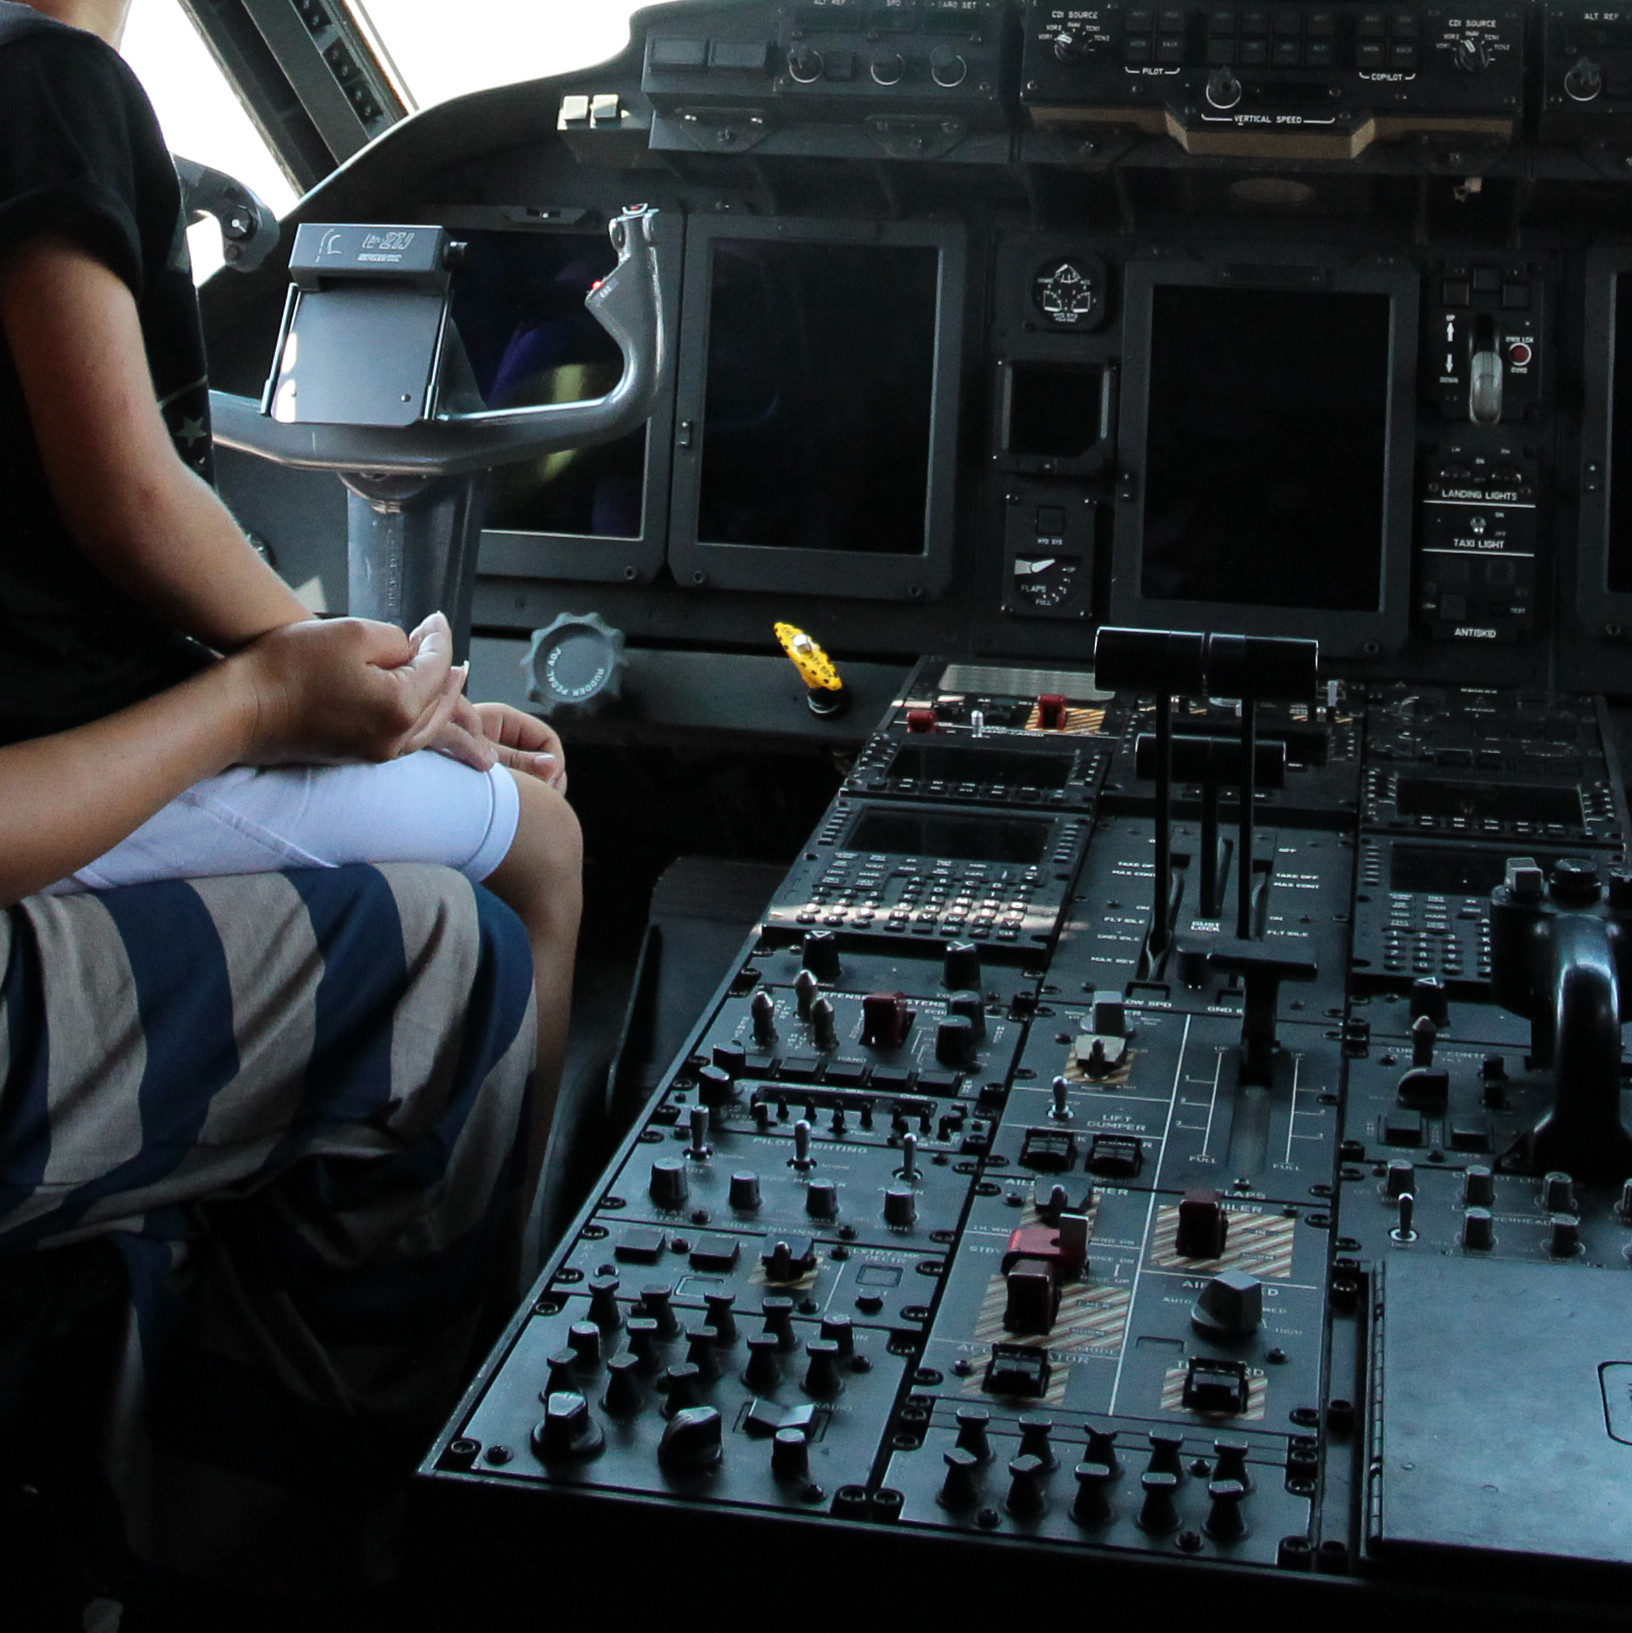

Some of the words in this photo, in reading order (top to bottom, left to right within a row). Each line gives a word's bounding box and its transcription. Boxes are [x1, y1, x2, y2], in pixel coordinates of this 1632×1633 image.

[1068, 11, 1098, 19] SOURCE
[1466, 20, 1496, 28] SOURCE
[1371, 73, 1403, 81] COPILOT
[1233, 115, 1272, 124] VERTICAL
[1276, 115, 1302, 124] SPEED
[1441, 489, 1483, 499] LANDING
[1485, 491, 1518, 501] LIGHTS
[1453, 538, 1475, 548] TAXI
[1478, 540, 1505, 550] LIGHT
[1454, 627, 1497, 639] ANTISKID
[1102, 1114, 1132, 1122] LIFT
[1086, 1121, 1146, 1132] DUMPER
